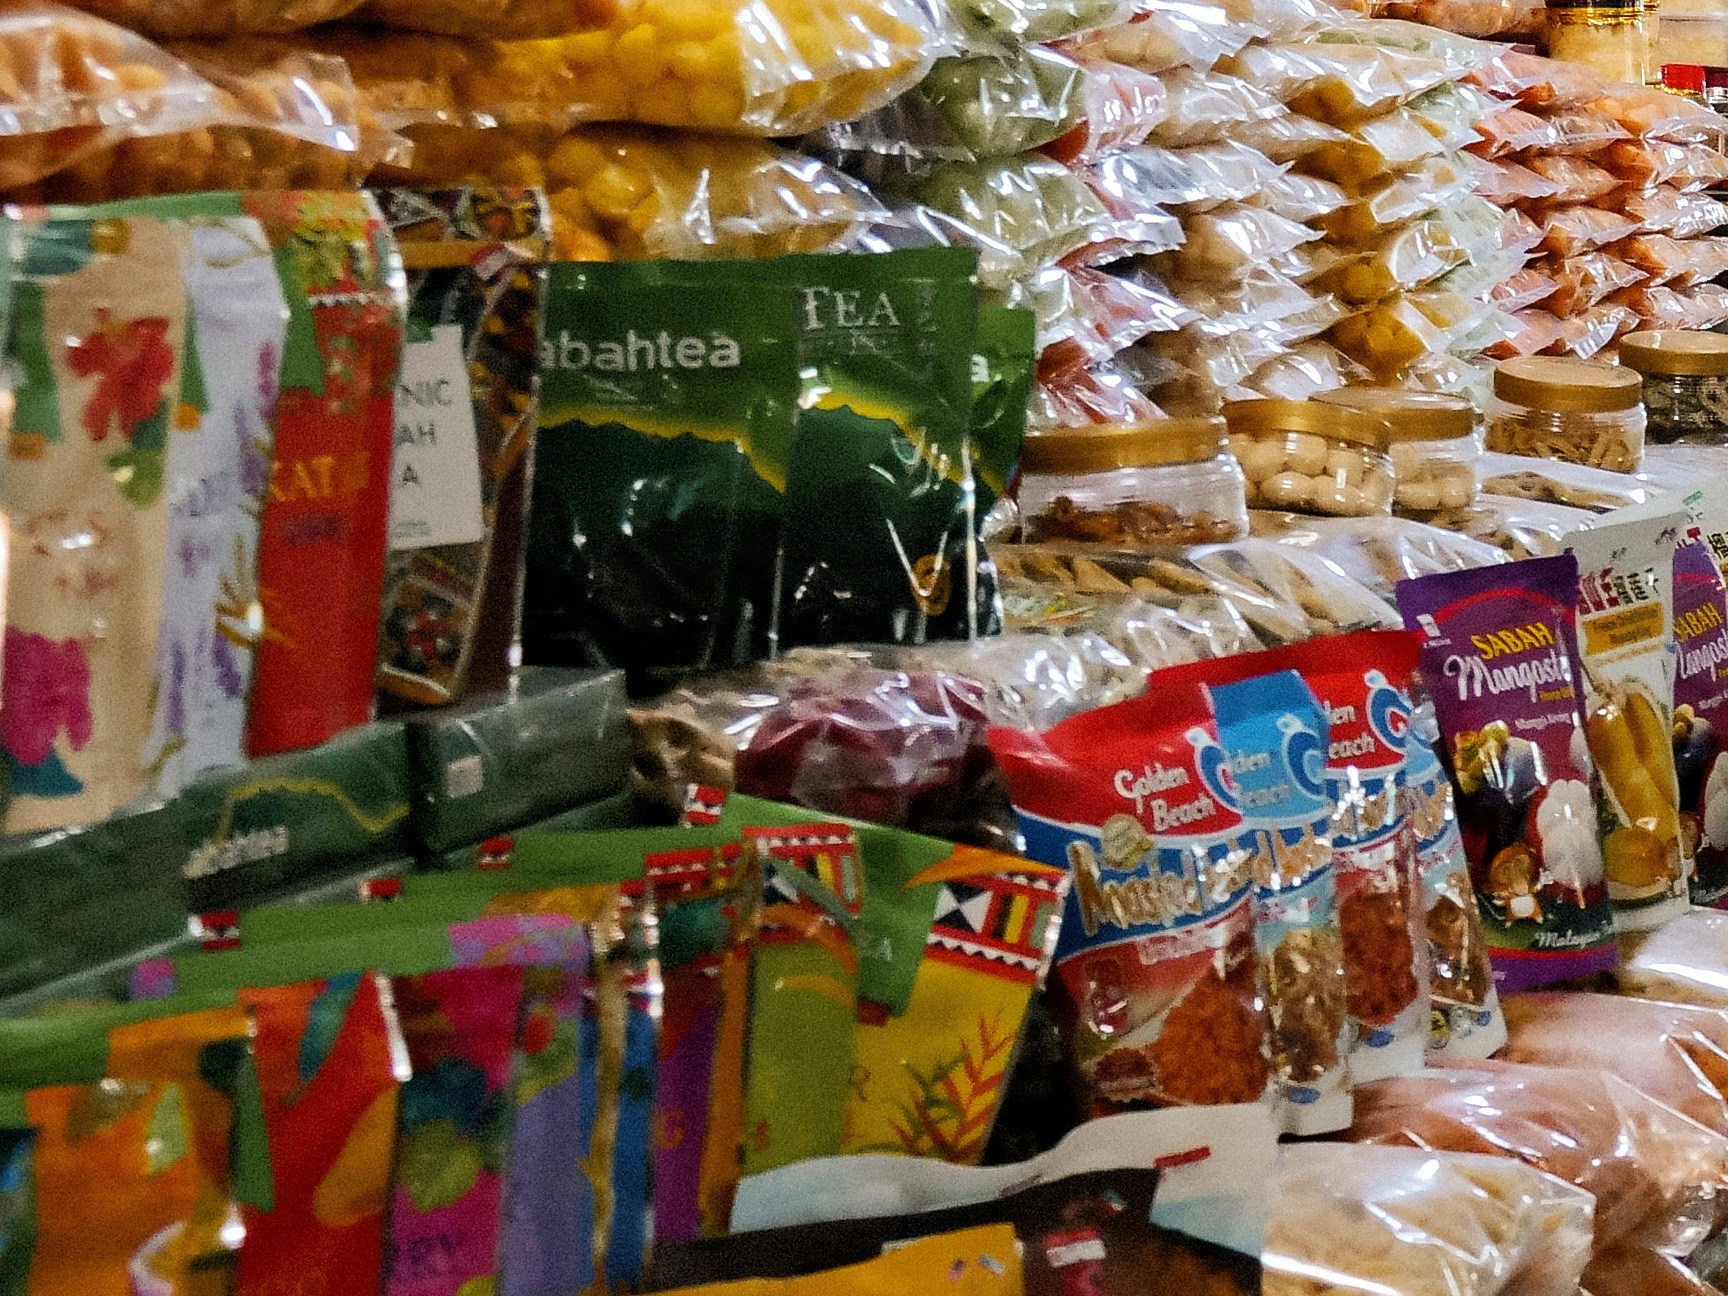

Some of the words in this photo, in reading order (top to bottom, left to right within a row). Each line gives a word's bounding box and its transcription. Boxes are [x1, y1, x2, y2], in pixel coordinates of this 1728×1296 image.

[801, 286, 901, 331] TEA
[1470, 620, 1557, 661] SABAH
[1113, 763, 1191, 814] Golden
[1152, 796, 1217, 833] Beach
